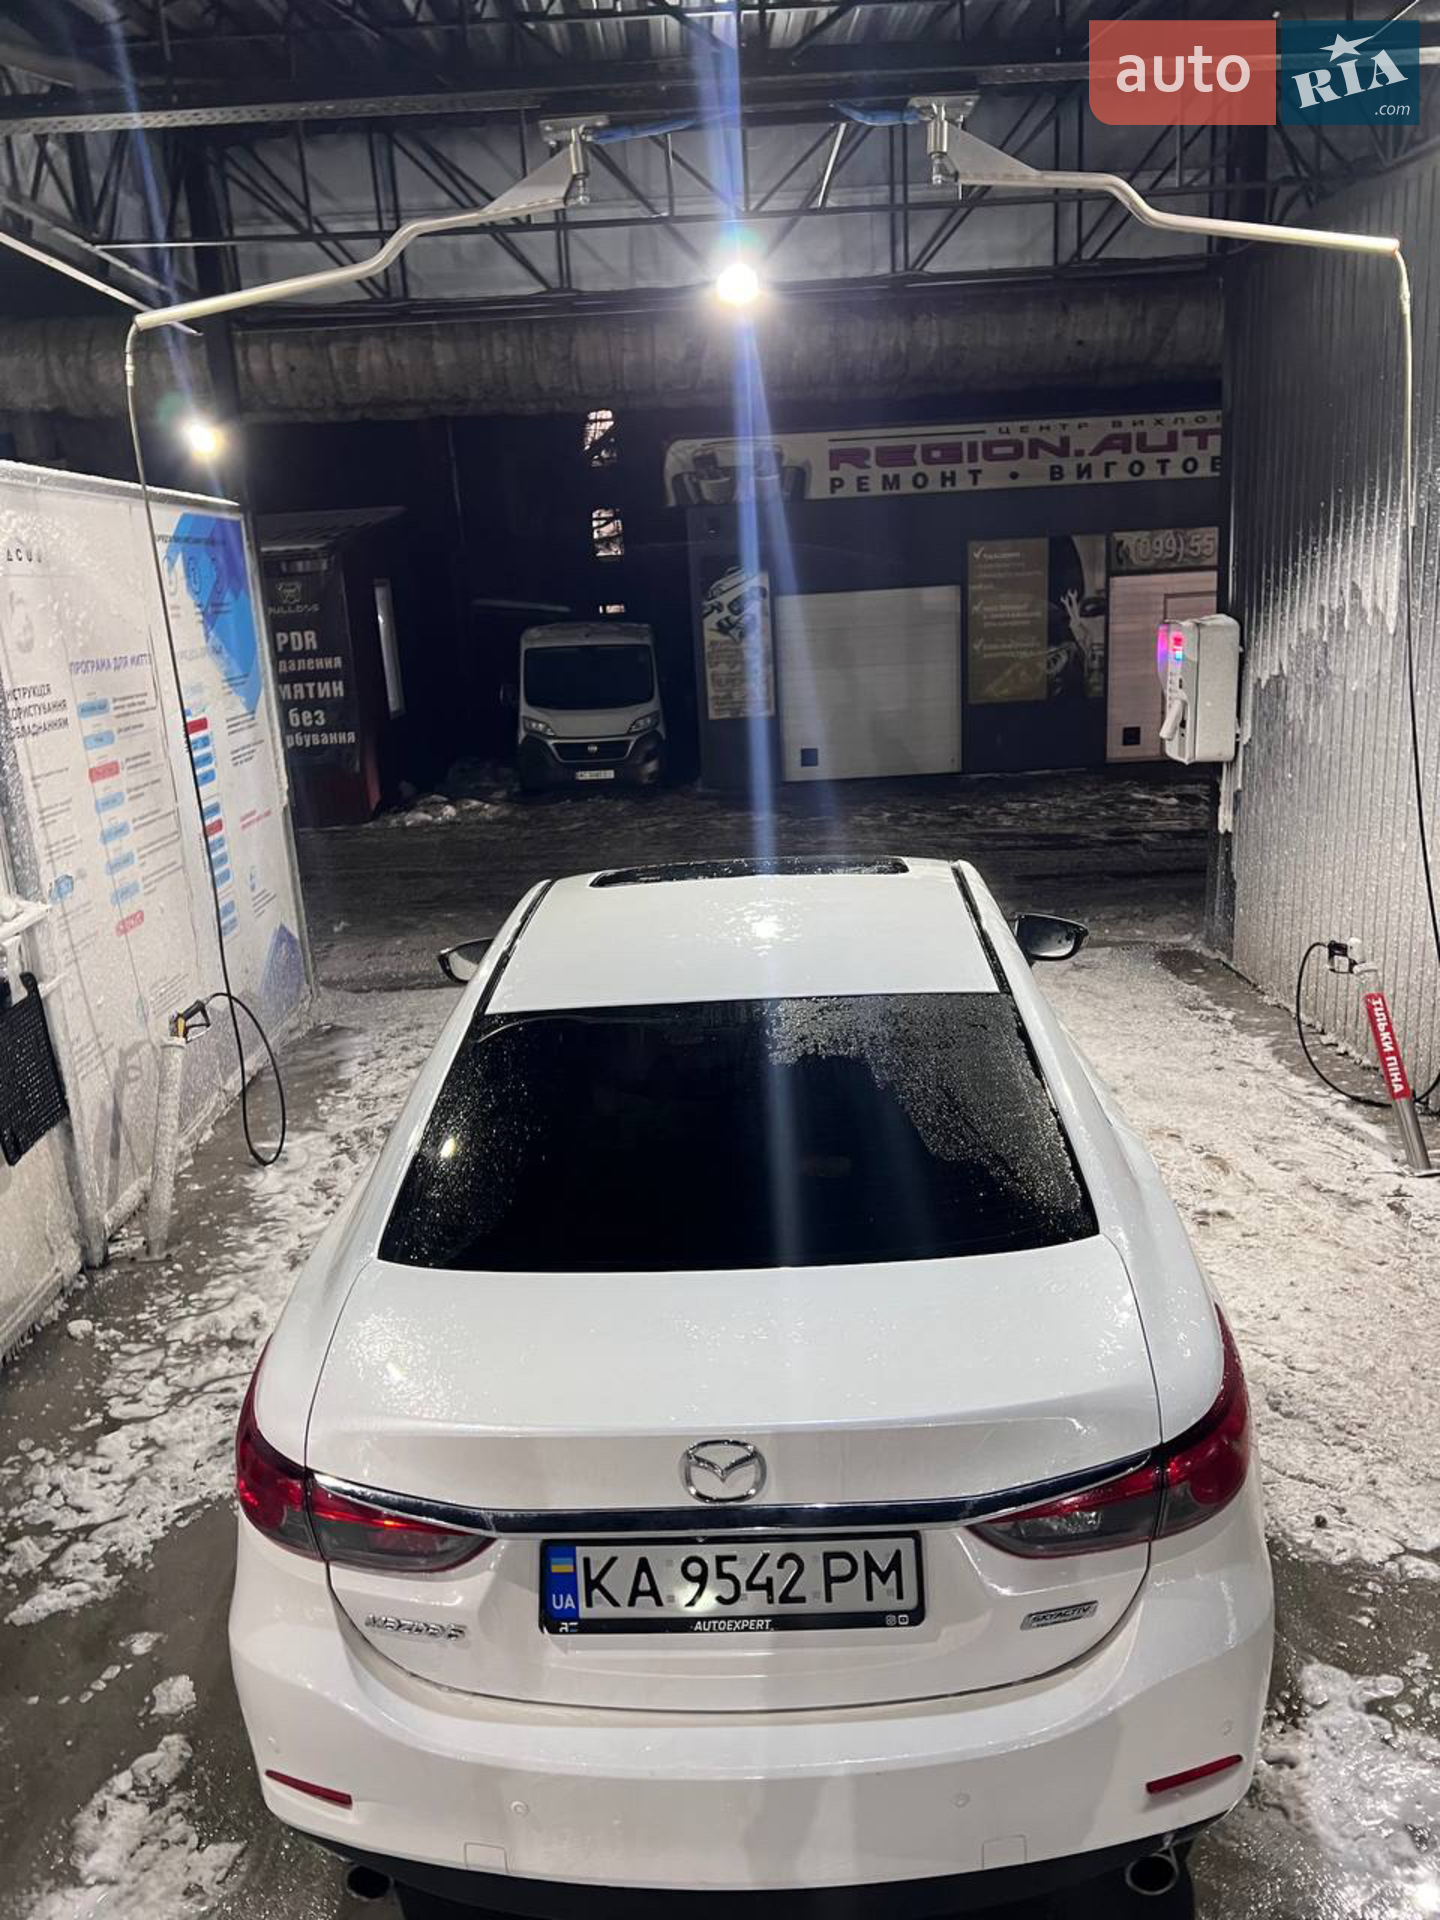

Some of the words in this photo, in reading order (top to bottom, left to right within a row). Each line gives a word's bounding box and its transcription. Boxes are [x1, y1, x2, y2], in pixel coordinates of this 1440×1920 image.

[998, 421, 1089, 434] ЦЕНТР
[829, 469, 983, 494] РЕМОНТ
[276, 630, 318, 653] PDR
[288, 707, 326, 727] без
[1371, 997, 1395, 1053] ТІЛЬКИ
[1385, 1056, 1405, 1094] ПІНА
[582, 1556, 664, 1609] KA
[680, 1551, 807, 1608] 9542
[822, 1549, 904, 1603] PM
[551, 1593, 577, 1610] UA
[694, 1619, 772, 1632] AUTOEXPERT
